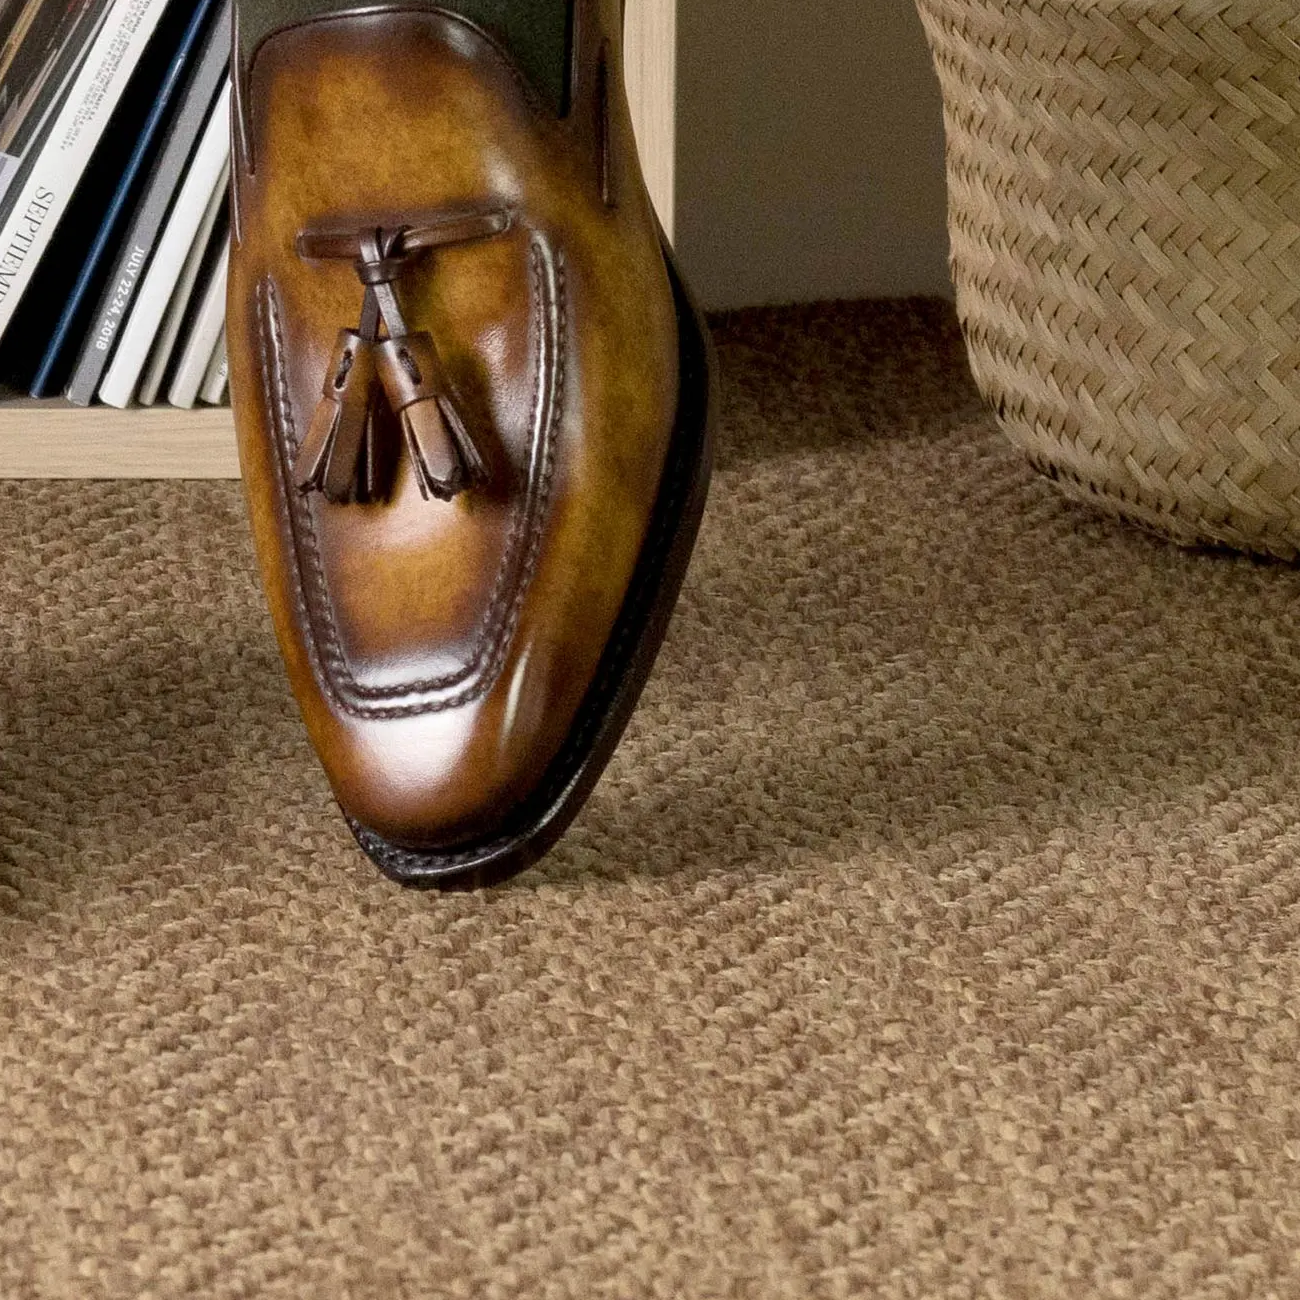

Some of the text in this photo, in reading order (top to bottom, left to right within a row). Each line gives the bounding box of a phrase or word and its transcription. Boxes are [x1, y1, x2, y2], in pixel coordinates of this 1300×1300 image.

[93, 244, 146, 352] JULY 22-24, 2018
